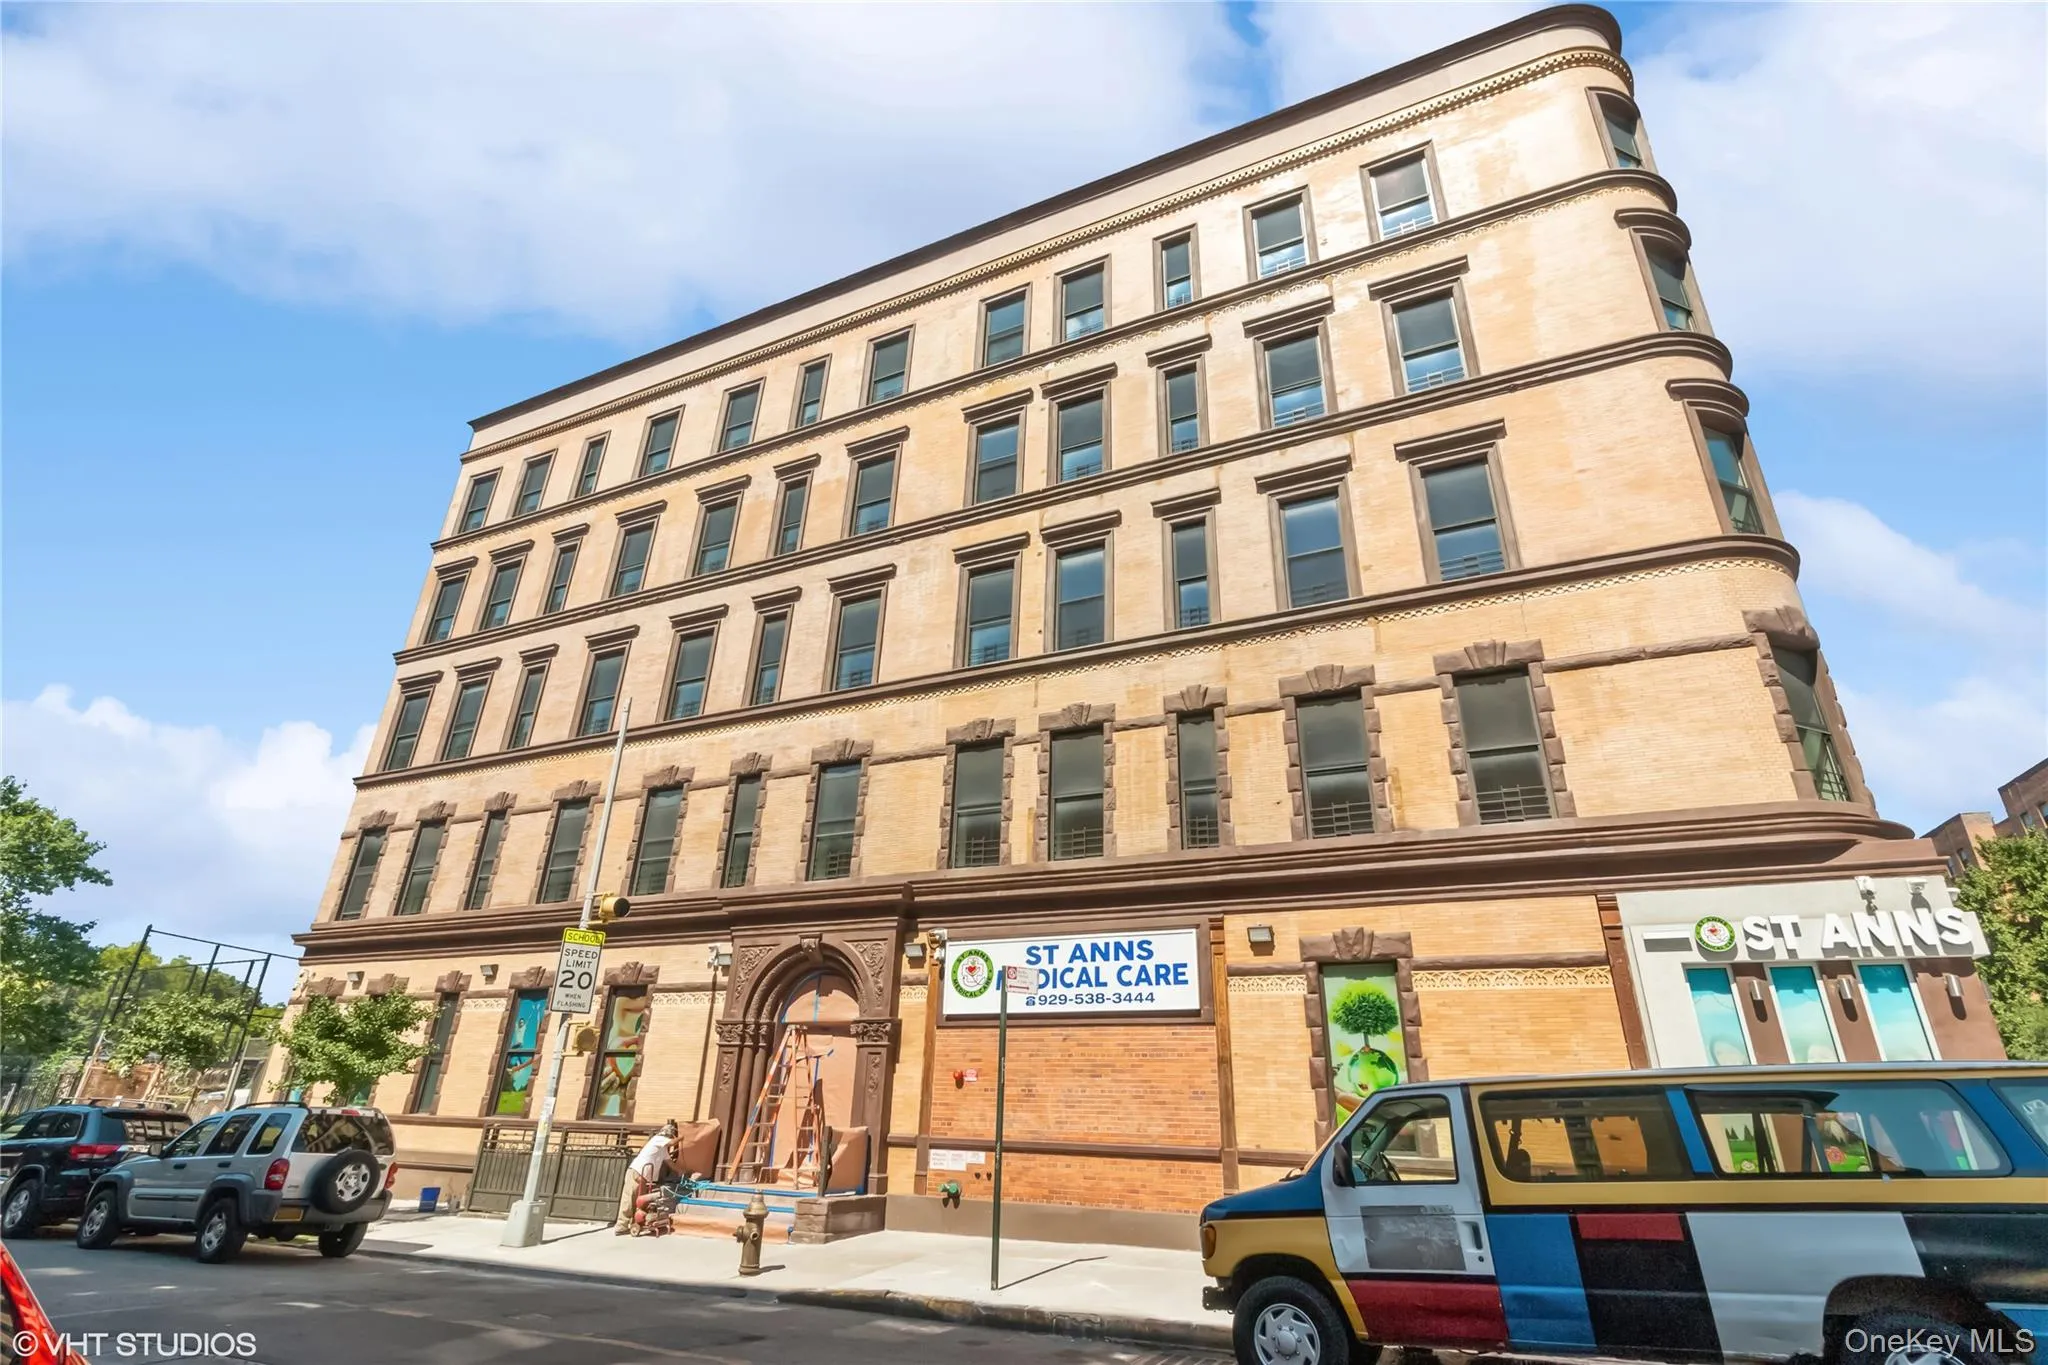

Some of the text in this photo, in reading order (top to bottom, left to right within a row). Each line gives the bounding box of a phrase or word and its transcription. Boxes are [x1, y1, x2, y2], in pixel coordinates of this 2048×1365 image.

[1743, 907, 1974, 950] ST ANNS
[567, 932, 601, 944] SCHOOL
[564, 948, 598, 960] SPEED
[1025, 939, 1154, 966] ST ANNS
[566, 960, 593, 969] LIMIT
[558, 970, 593, 990] 20
[996, 962, 1189, 991] DICAL CARE
[557, 1001, 586, 1009] FLASHING
[1038, 992, 1155, 1006] 929-538-3444
